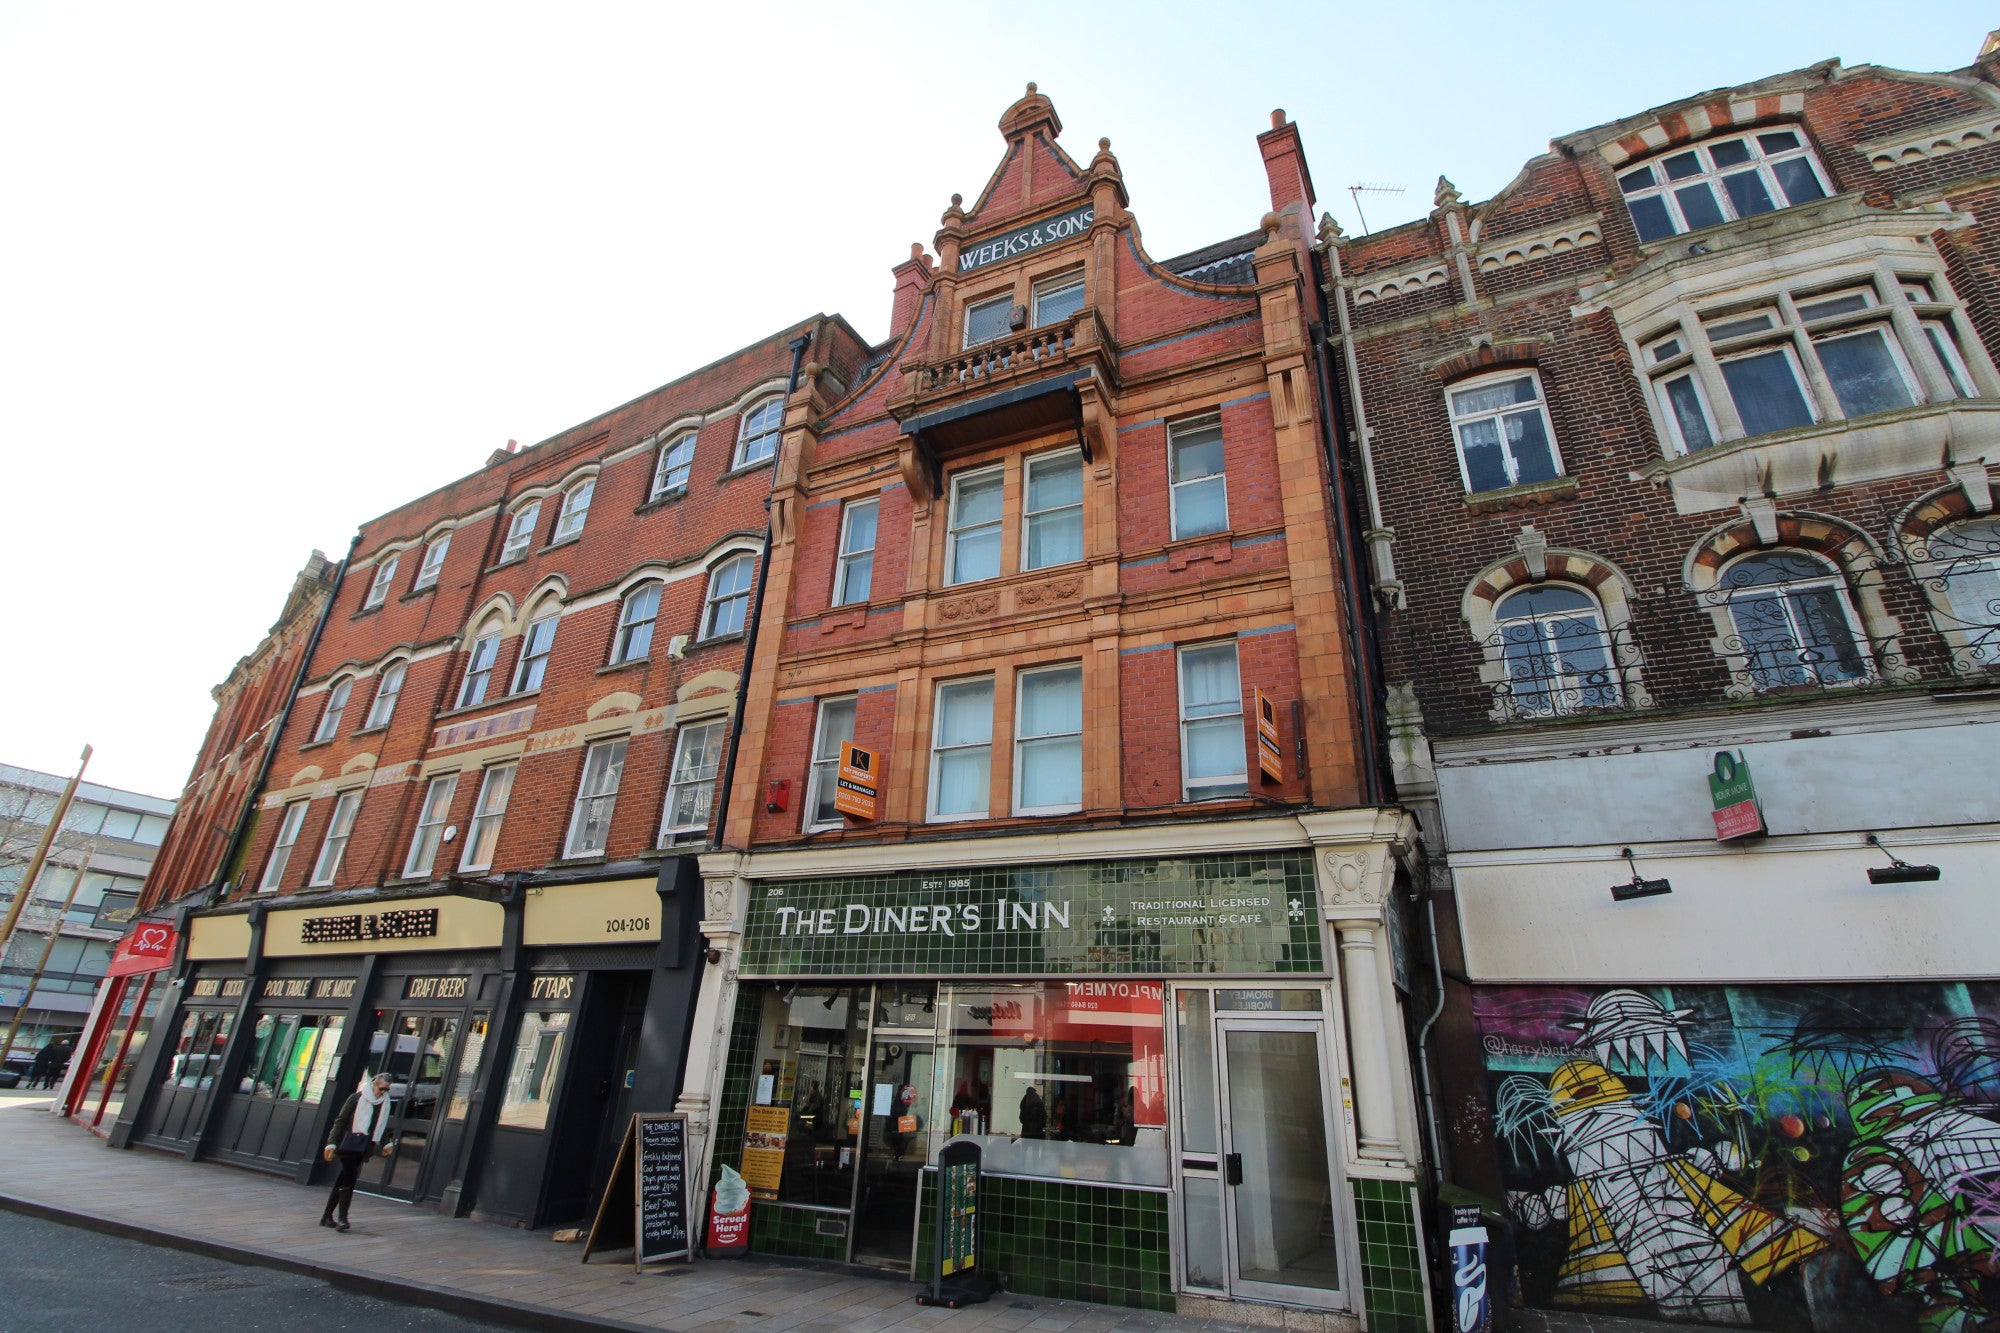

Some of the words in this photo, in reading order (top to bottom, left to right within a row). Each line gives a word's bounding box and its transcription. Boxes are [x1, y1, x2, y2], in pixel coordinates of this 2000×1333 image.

[959, 233, 1029, 271] WEEKS
[1030, 229, 1043, 247] &
[1046, 210, 1095, 242] SONS
[1714, 789, 1731, 800] YOUR
[1731, 782, 1748, 794] MOVE
[948, 879, 970, 889] 1985
[768, 888, 784, 897] 206
[1130, 899, 1206, 911] TRADITIONAL
[1210, 897, 1270, 908] LICENSED
[775, 906, 837, 936] THE
[843, 904, 981, 937] DINER'S
[997, 898, 1070, 931] INN
[1137, 915, 1214, 926] RESTAURANT
[1218, 915, 1227, 924] &
[606, 918, 650, 933] 204-206
[263, 980, 286, 997] POOL
[286, 980, 310, 997] TABLE
[316, 980, 332, 997] LIVE
[331, 980, 356, 998] MUSIC
[410, 978, 437, 998] CRAFT
[437, 978, 468, 998] BEERS
[531, 977, 546, 998] 17
[546, 977, 574, 999] TAPS
[670, 1122, 680, 1130] INN
[644, 1199, 661, 1211] Beef
[713, 1214, 748, 1224] Served
[716, 1223, 742, 1232] Here!
